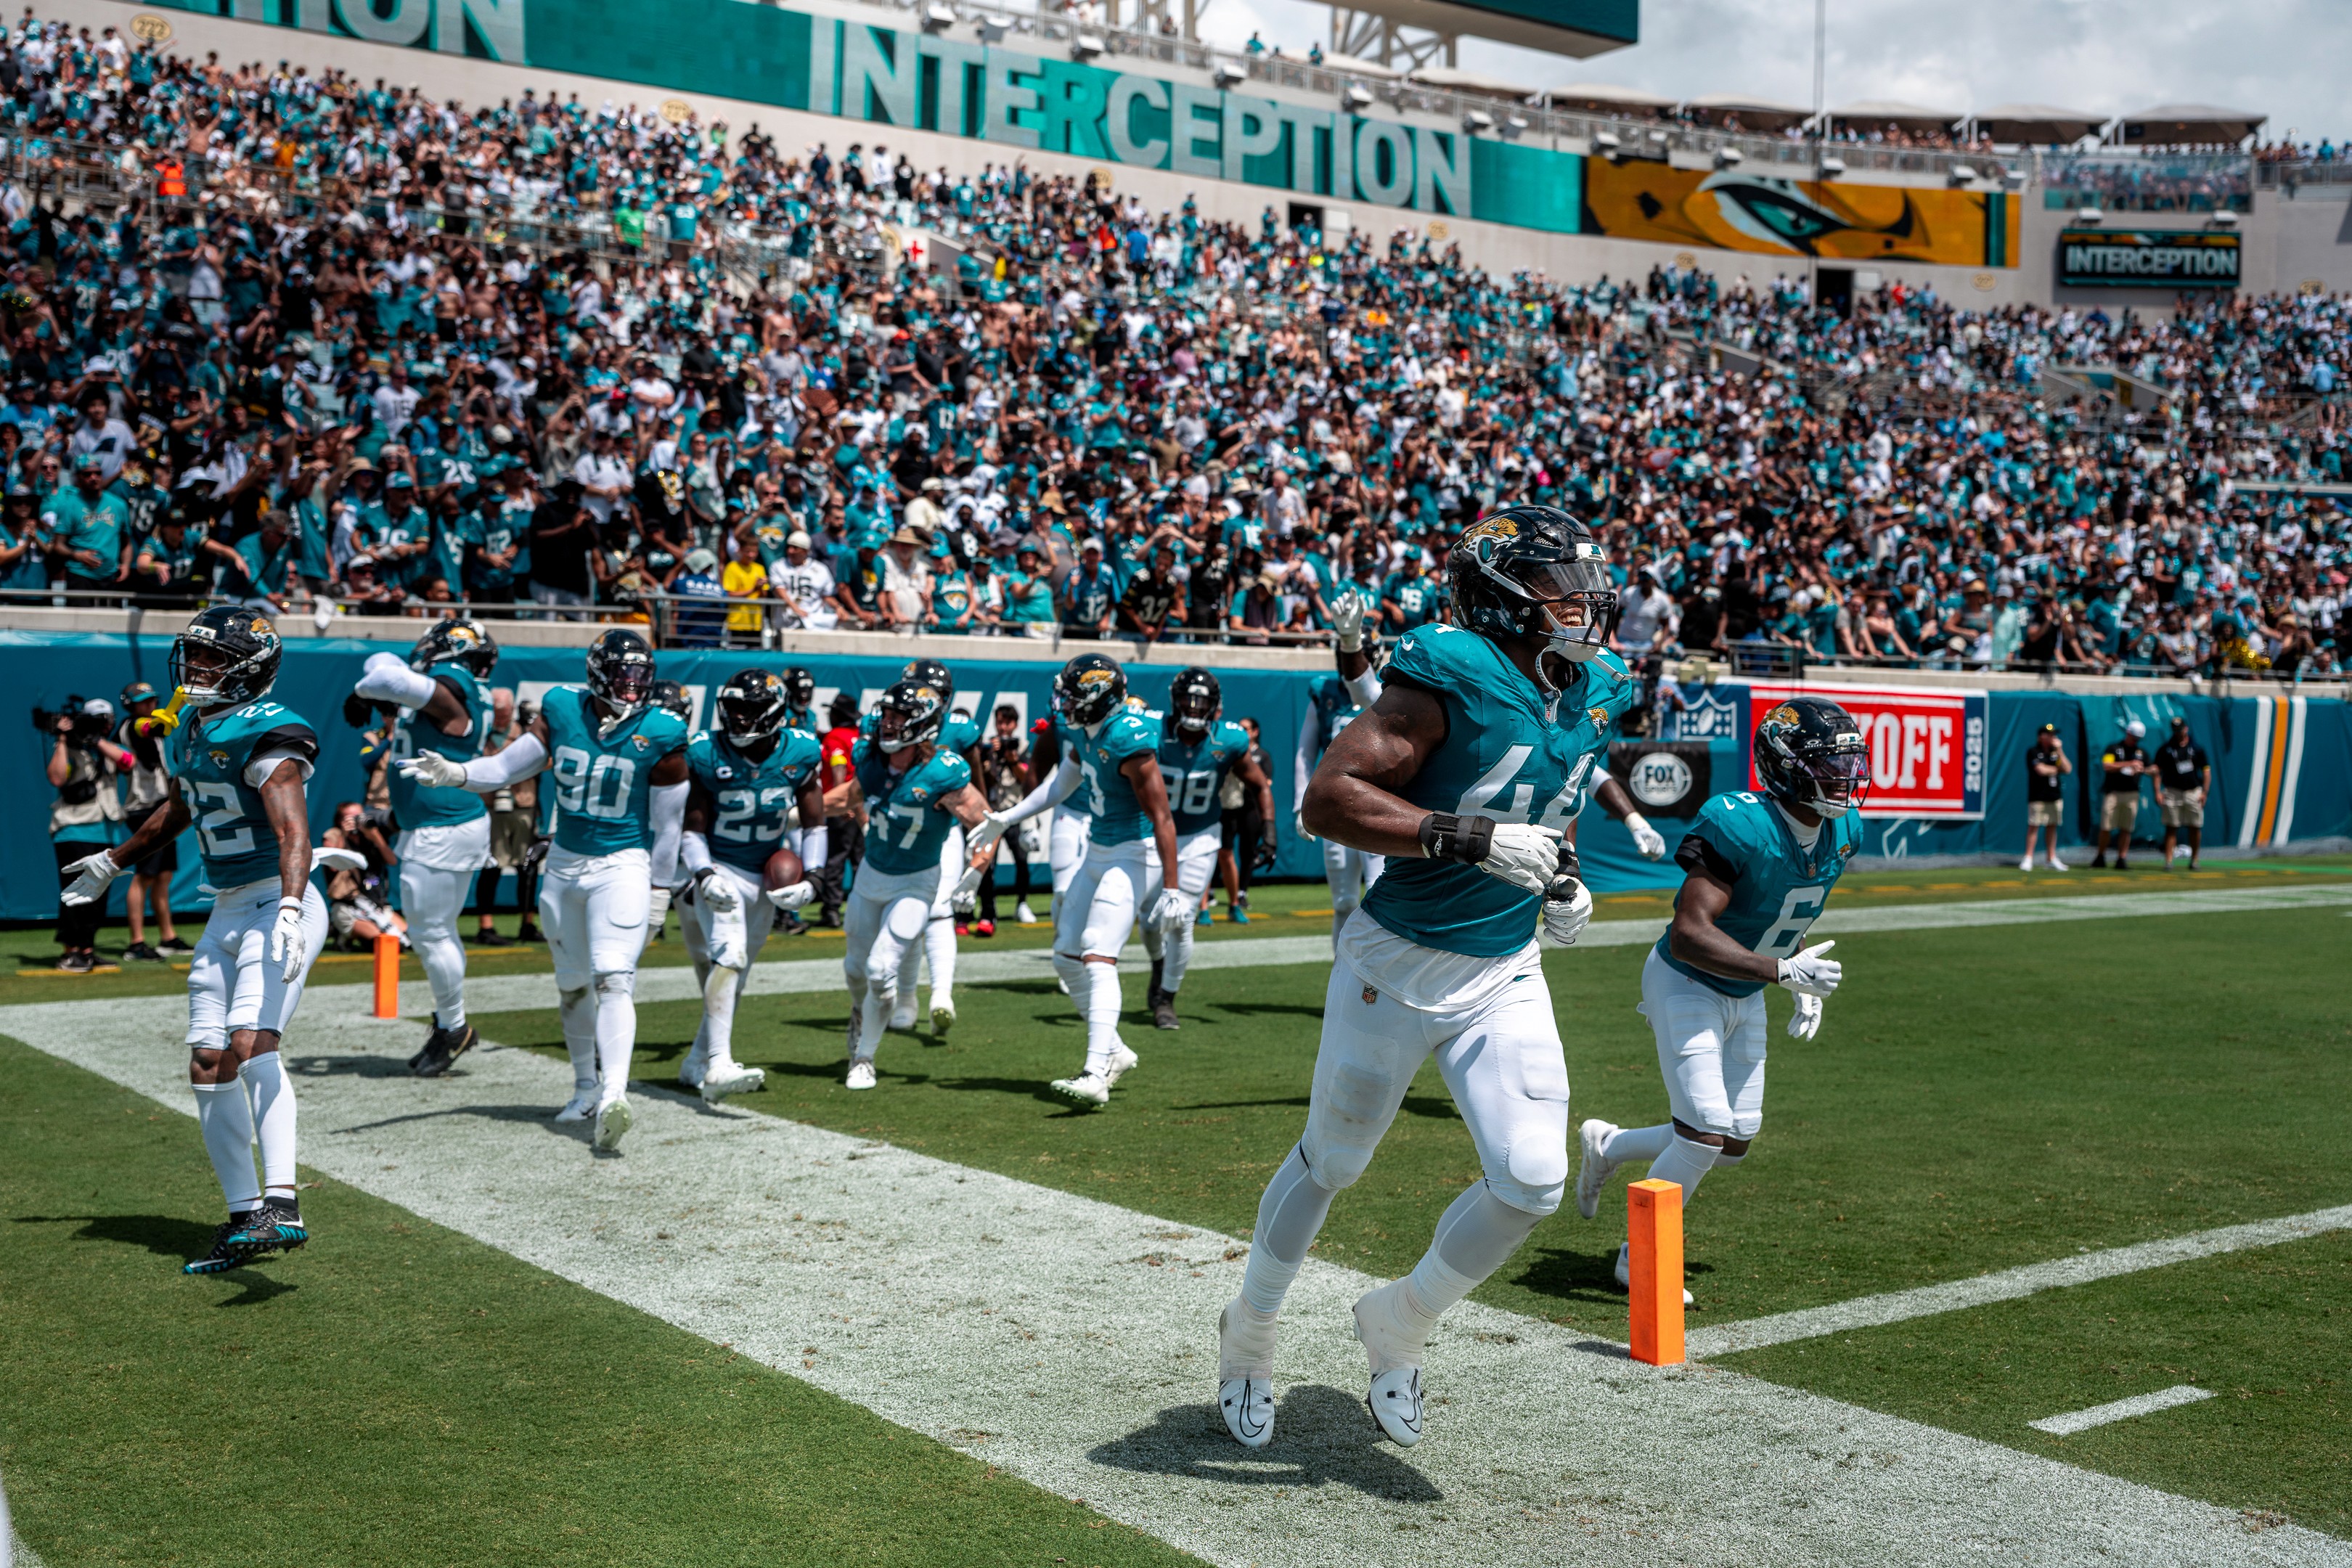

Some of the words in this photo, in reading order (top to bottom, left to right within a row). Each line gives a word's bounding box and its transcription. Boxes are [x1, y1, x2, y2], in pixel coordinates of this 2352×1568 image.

[809, 15, 1472, 218] INTERCEPTION
[2065, 245, 2237, 276] INTERCEPTION
[554, 745, 637, 819] 90
[716, 765, 733, 779] C
[1644, 766, 1676, 784] FOX
[714, 786, 795, 842] 23
[1753, 885, 1825, 959] 6
